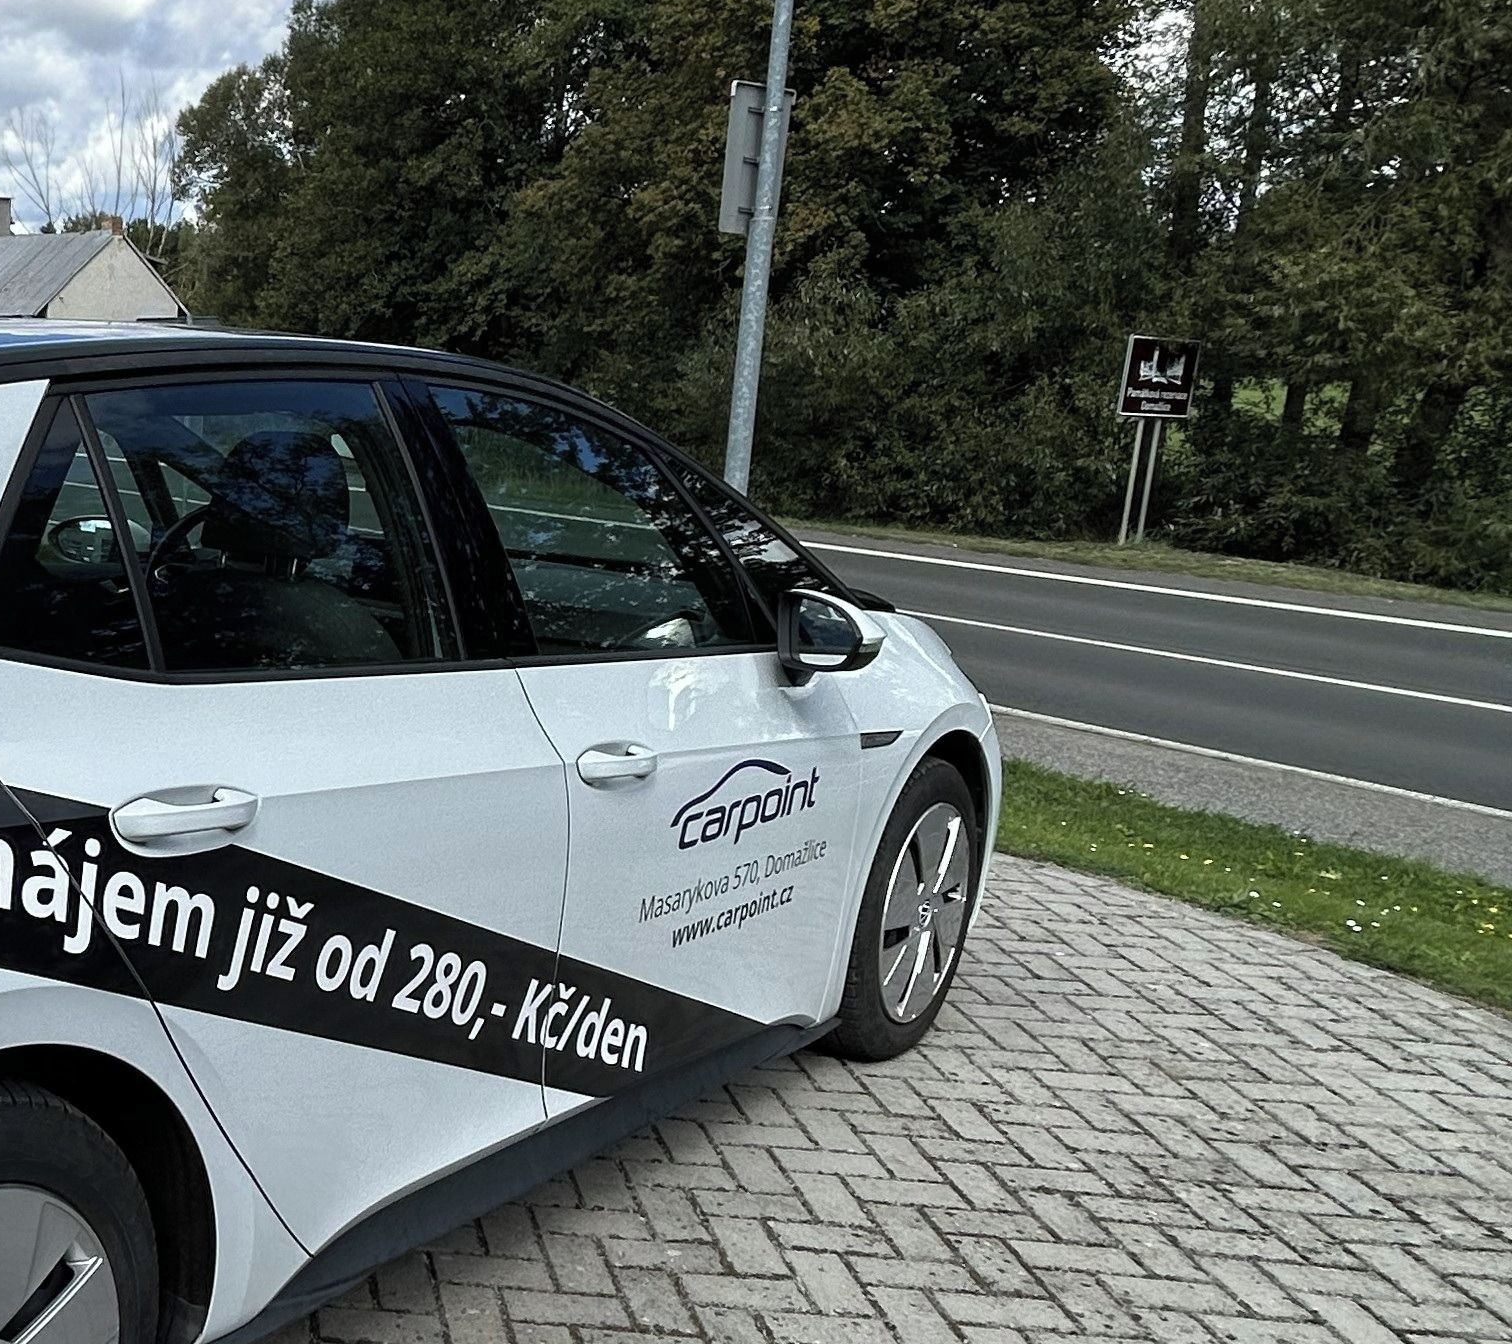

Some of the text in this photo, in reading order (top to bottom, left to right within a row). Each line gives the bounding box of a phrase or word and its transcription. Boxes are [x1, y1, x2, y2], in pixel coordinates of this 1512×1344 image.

[678, 766, 820, 850] carpoint
[638, 839, 827, 923] Masarykova 570, Domažlice
[672, 885, 795, 948] www.carpoint.cz
[216, 886, 315, 991] již
[315, 928, 397, 1002] od
[392, 943, 507, 1041] 280,-
[511, 978, 650, 1073] Kč/den
